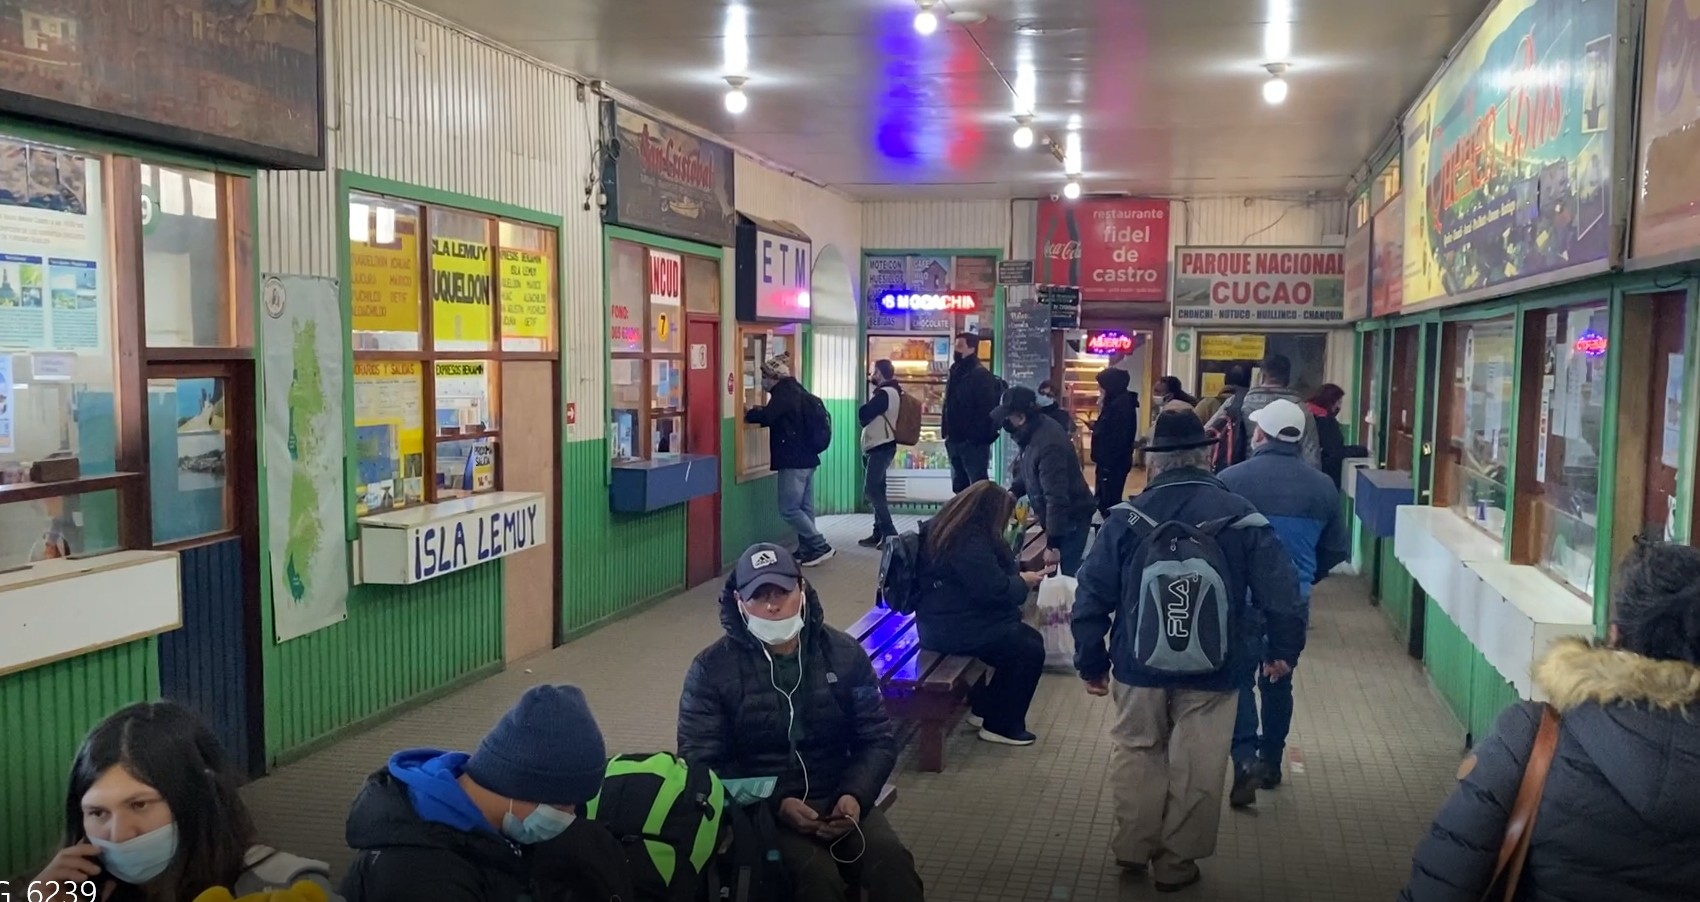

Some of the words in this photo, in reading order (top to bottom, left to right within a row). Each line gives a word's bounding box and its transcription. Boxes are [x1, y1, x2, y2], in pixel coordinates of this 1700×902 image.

[1092, 209, 1164, 219] restaurante
[1104, 226, 1150, 243] fidel
[452, 241, 488, 261] LEMUY
[1112, 246, 1139, 263] de
[1092, 266, 1158, 282] castro
[1182, 252, 1251, 276] PARQUE
[1255, 252, 1346, 275] NACIONAL
[433, 268, 490, 306] UQUELDON
[1211, 281, 1313, 305] CUCAO
[1178, 309, 1213, 319] CHONCHI
[1218, 309, 1251, 319] NOTUCO
[1256, 309, 1298, 319] HUILLINCO
[660, 314, 667, 335] 7
[1174, 332, 1191, 352] 6
[355, 363, 380, 375] ORARIOS
[478, 503, 536, 560] LEMUY
[1167, 579, 1189, 637] FILA
